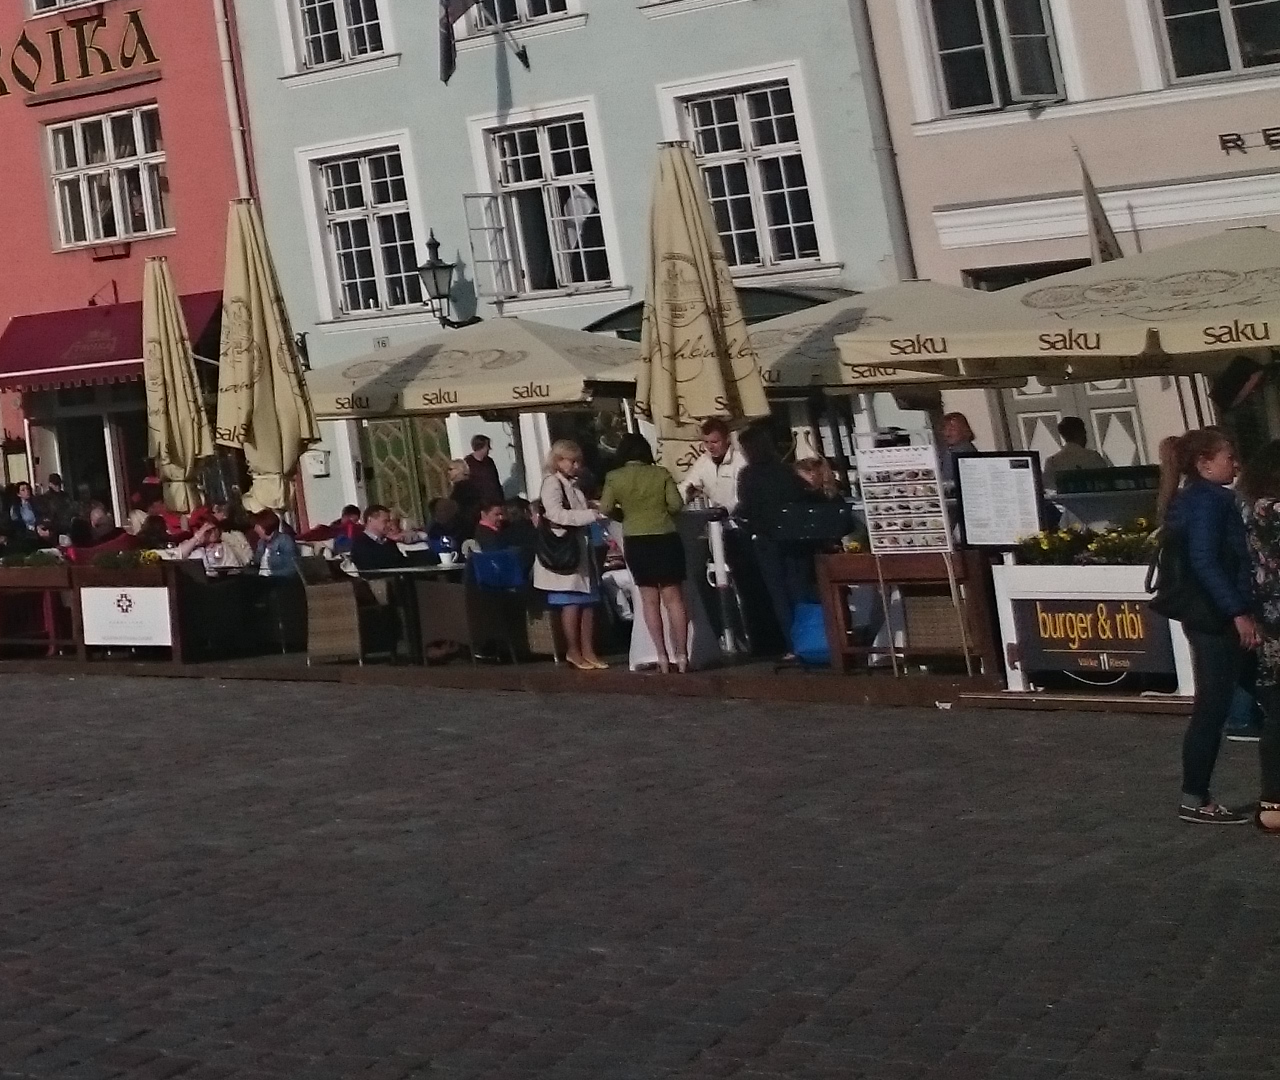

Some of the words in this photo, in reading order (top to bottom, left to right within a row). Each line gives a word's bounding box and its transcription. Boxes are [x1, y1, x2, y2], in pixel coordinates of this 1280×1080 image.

[1038, 328, 1101, 351] saku
[1203, 319, 1270, 345] saku
[375, 340, 387, 349] 16
[889, 334, 947, 356] saku
[335, 392, 369, 409] saku
[423, 388, 458, 406] saku
[513, 381, 550, 400] saku
[676, 444, 708, 472] sak
[1036, 600, 1093, 649] burger
[1097, 602, 1112, 639] &
[1115, 601, 1145, 639] ribi
